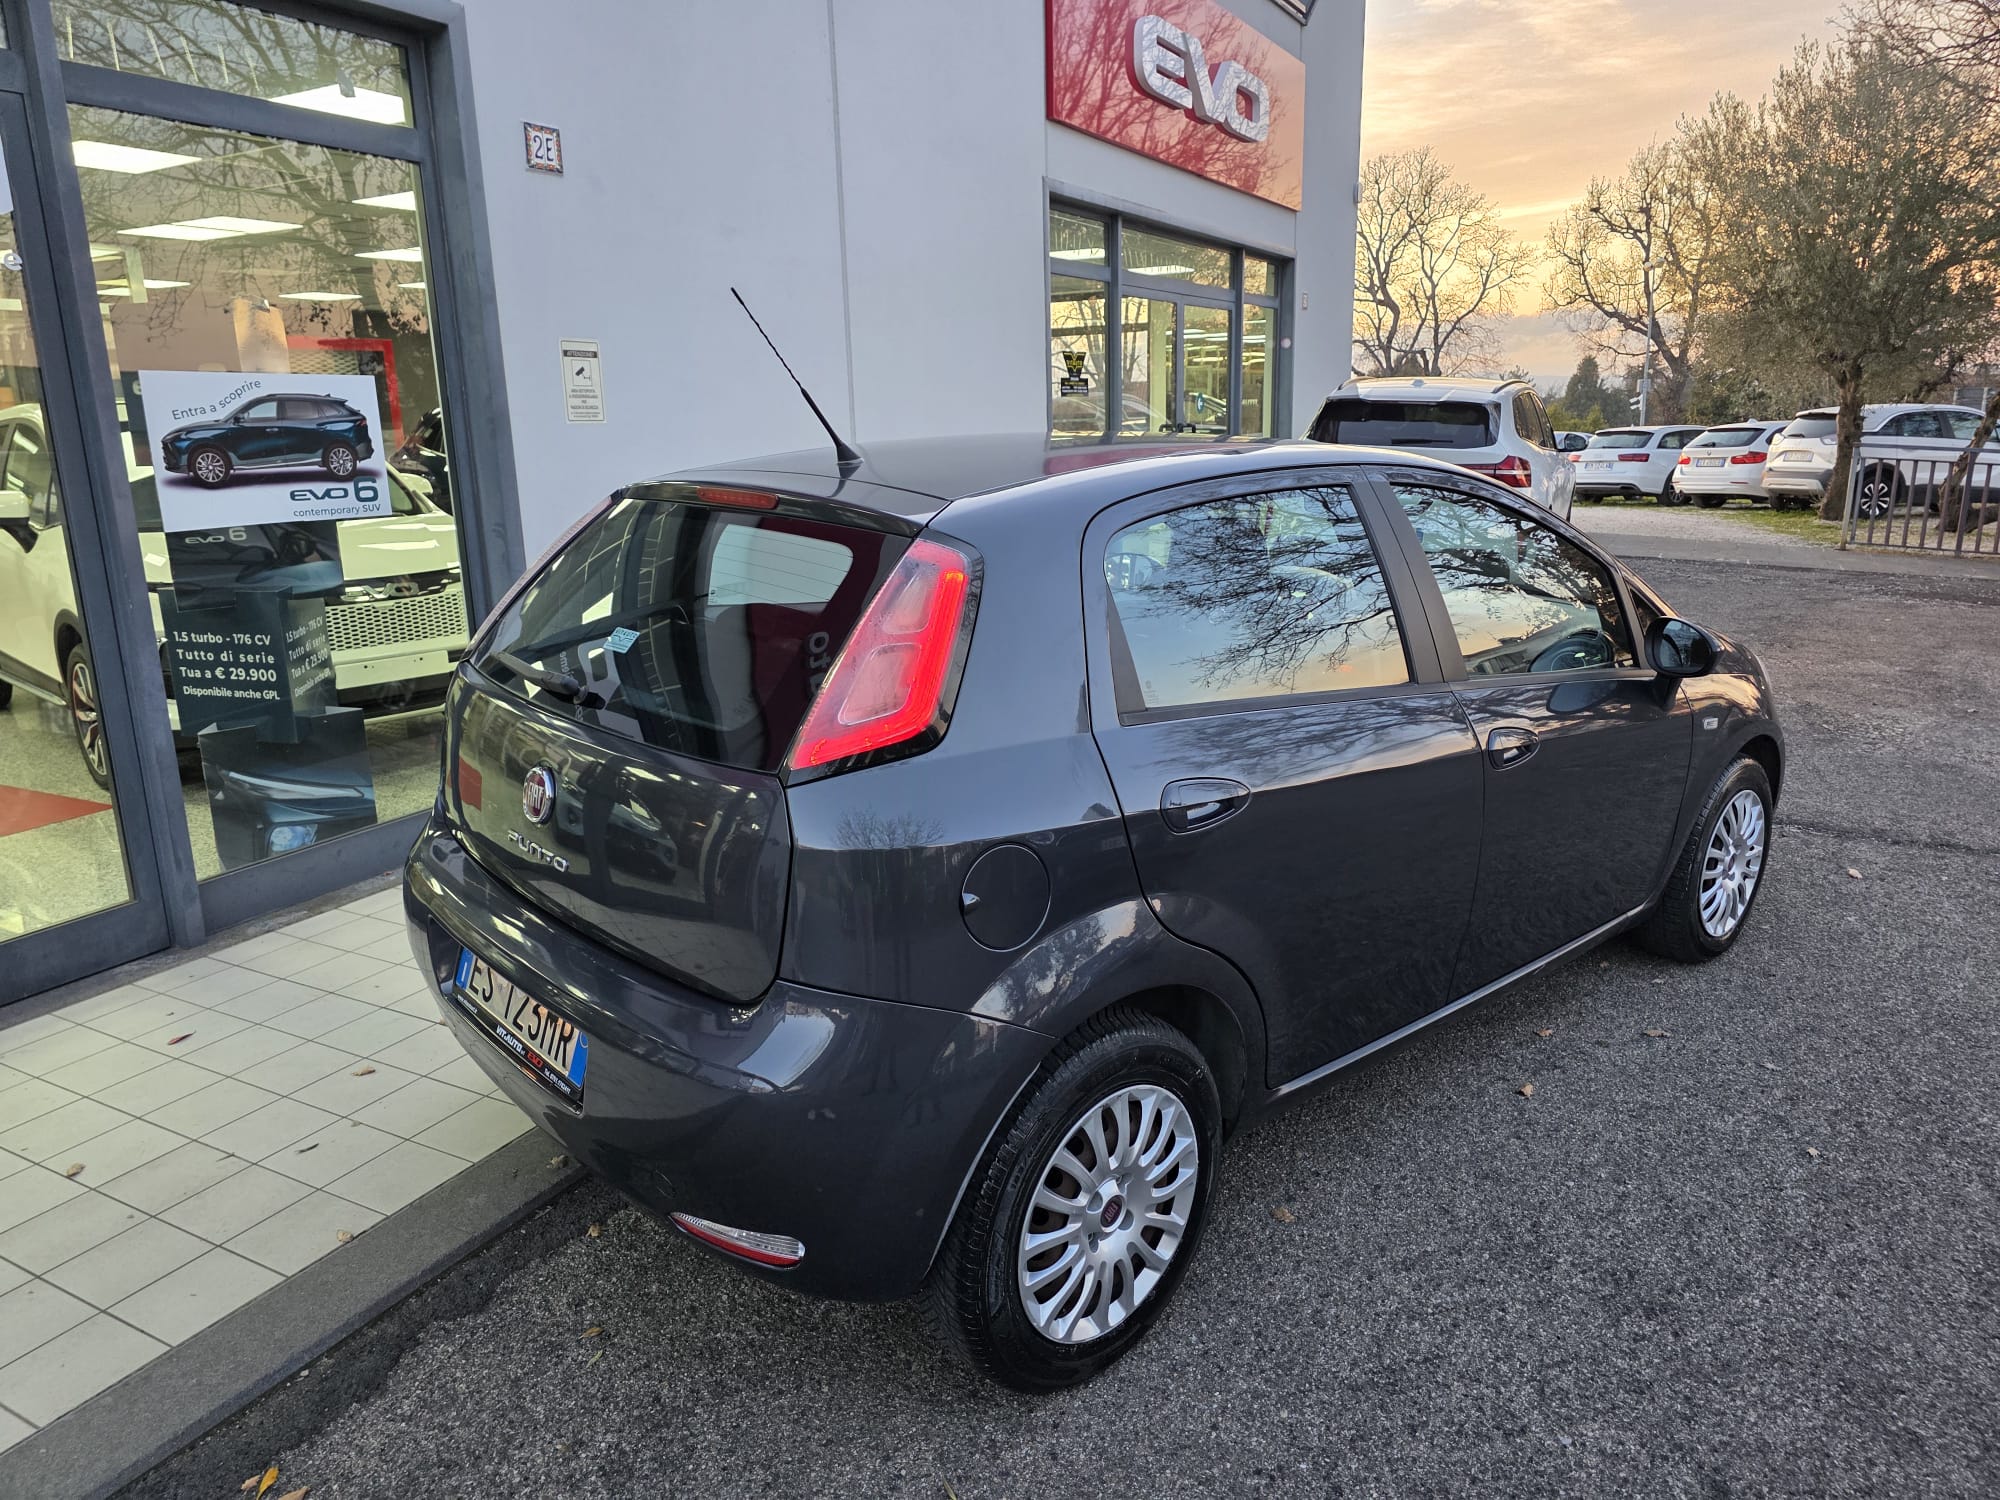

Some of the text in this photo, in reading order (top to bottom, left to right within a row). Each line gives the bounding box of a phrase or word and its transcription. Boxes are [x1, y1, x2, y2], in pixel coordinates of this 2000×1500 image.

[1131, 15, 1270, 143] EVO
[533, 134, 554, 162] 2E
[171, 380, 262, 420] Entra a scoprire
[289, 476, 379, 502] EVO 6
[293, 504, 381, 517] contemporary SUV
[184, 527, 247, 544] EVO 6
[173, 631, 188, 642] 1.5
[190, 632, 223, 644] turbo
[232, 633, 252, 645] 176
[254, 634, 271, 646] CV
[176, 648, 275, 664] Tutto di serie
[179, 666, 277, 682] Tua a € 29.900
[182, 685, 281, 701] Disponibile anche GPL
[528, 782, 544, 809] FIAT
[507, 830, 569, 872] PUNTO
